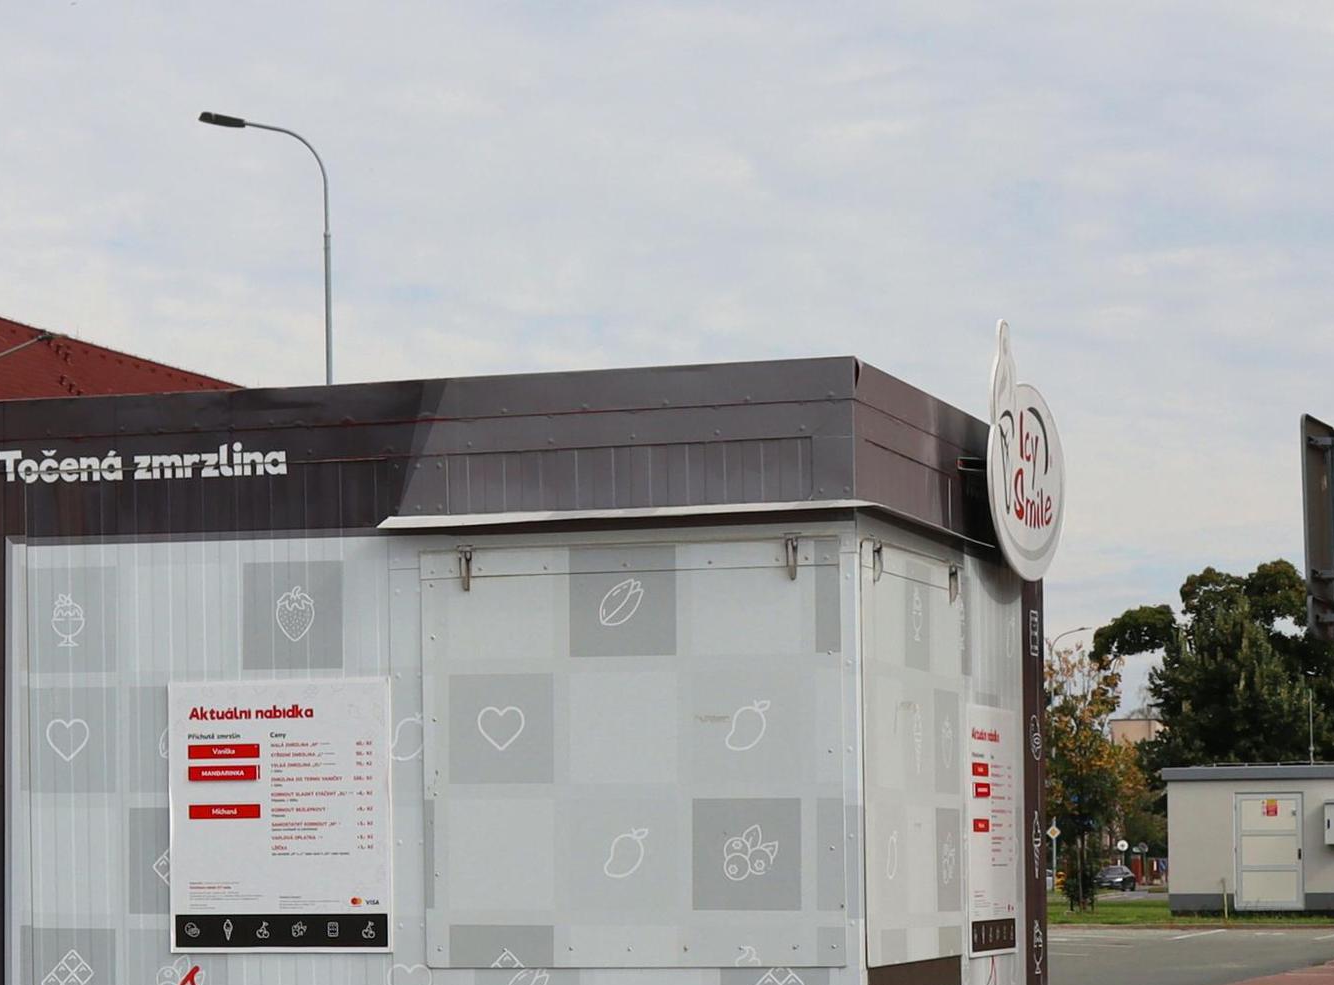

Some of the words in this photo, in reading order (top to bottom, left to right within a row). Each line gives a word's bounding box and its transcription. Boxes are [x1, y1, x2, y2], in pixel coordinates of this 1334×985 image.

[133, 441, 288, 481] zmrzlina
[1020, 411, 1039, 490] Icy
[1014, 468, 1053, 530] Smile
